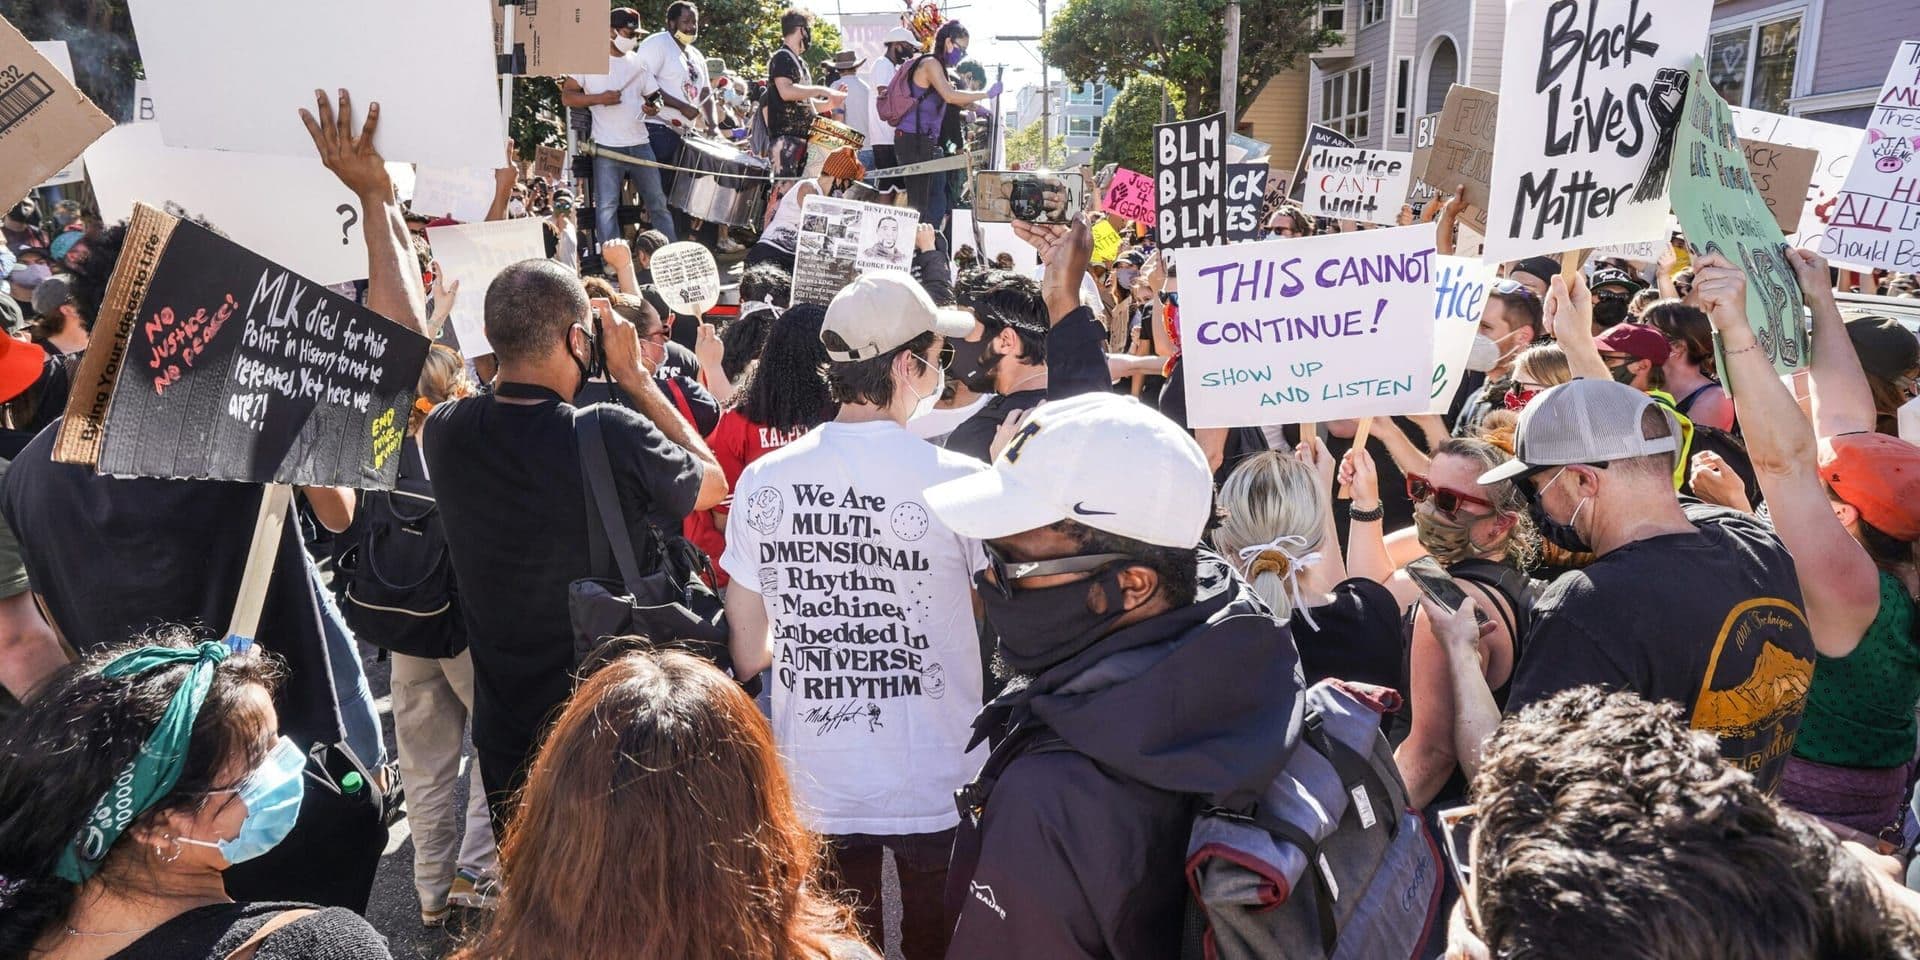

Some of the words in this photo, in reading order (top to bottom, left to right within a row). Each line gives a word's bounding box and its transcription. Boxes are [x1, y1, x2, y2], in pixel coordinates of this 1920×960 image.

[1536, 0, 1659, 101] Black
[1544, 83, 1648, 158] Lives
[1159, 120, 1219, 165] BLM
[1315, 132, 1332, 142] BAY
[1137, 192, 1149, 205] 4
[1159, 160, 1219, 206] BLM
[1320, 174, 1387, 193] CAN'T
[1890, 176, 1920, 203] H
[894, 210, 919, 219] POWER
[1226, 204, 1257, 232] ES
[1320, 195, 1378, 220] wait
[1509, 168, 1633, 240] Matter
[1832, 193, 1889, 229] ALL
[1899, 205, 1920, 231] Li
[1159, 199, 1219, 244] BLM
[1821, 227, 1889, 262] Should
[1198, 257, 1304, 304] THIS
[1314, 248, 1436, 289] CANNOT
[144, 306, 174, 344] NO
[246, 268, 308, 329] MLK
[305, 297, 341, 341] died
[344, 318, 364, 351] for
[364, 328, 388, 358] this
[1196, 298, 1388, 345] CONTINUE!
[81, 390, 109, 440] Bring
[97, 344, 123, 388] Your
[114, 291, 140, 343] Ideas
[133, 270, 148, 290] to
[242, 319, 280, 355] Point
[285, 331, 296, 357] in
[299, 339, 338, 375] History
[337, 349, 350, 375] to
[350, 358, 369, 382] not
[370, 364, 383, 384] be
[154, 364, 182, 396] NO
[234, 354, 297, 400] repeated,
[299, 368, 324, 401] Yet
[327, 377, 351, 407] here
[354, 391, 370, 413] we
[1200, 364, 1272, 388] SHOW
[1290, 361, 1323, 378] UP
[1260, 386, 1310, 407] AND
[1322, 375, 1413, 401] LISTEN
[792, 484, 835, 507] We
[839, 486, 886, 512] Are
[792, 513, 881, 538] MULTI-
[760, 541, 929, 571] DMENSIONAL
[785, 567, 896, 596] Rhythm
[780, 594, 906, 621] Machines
[903, 621, 930, 649] In
[780, 645, 795, 666] A
[795, 646, 923, 673] UNIVERSE
[779, 667, 797, 693] OF
[804, 677, 923, 700] RHYTHM
